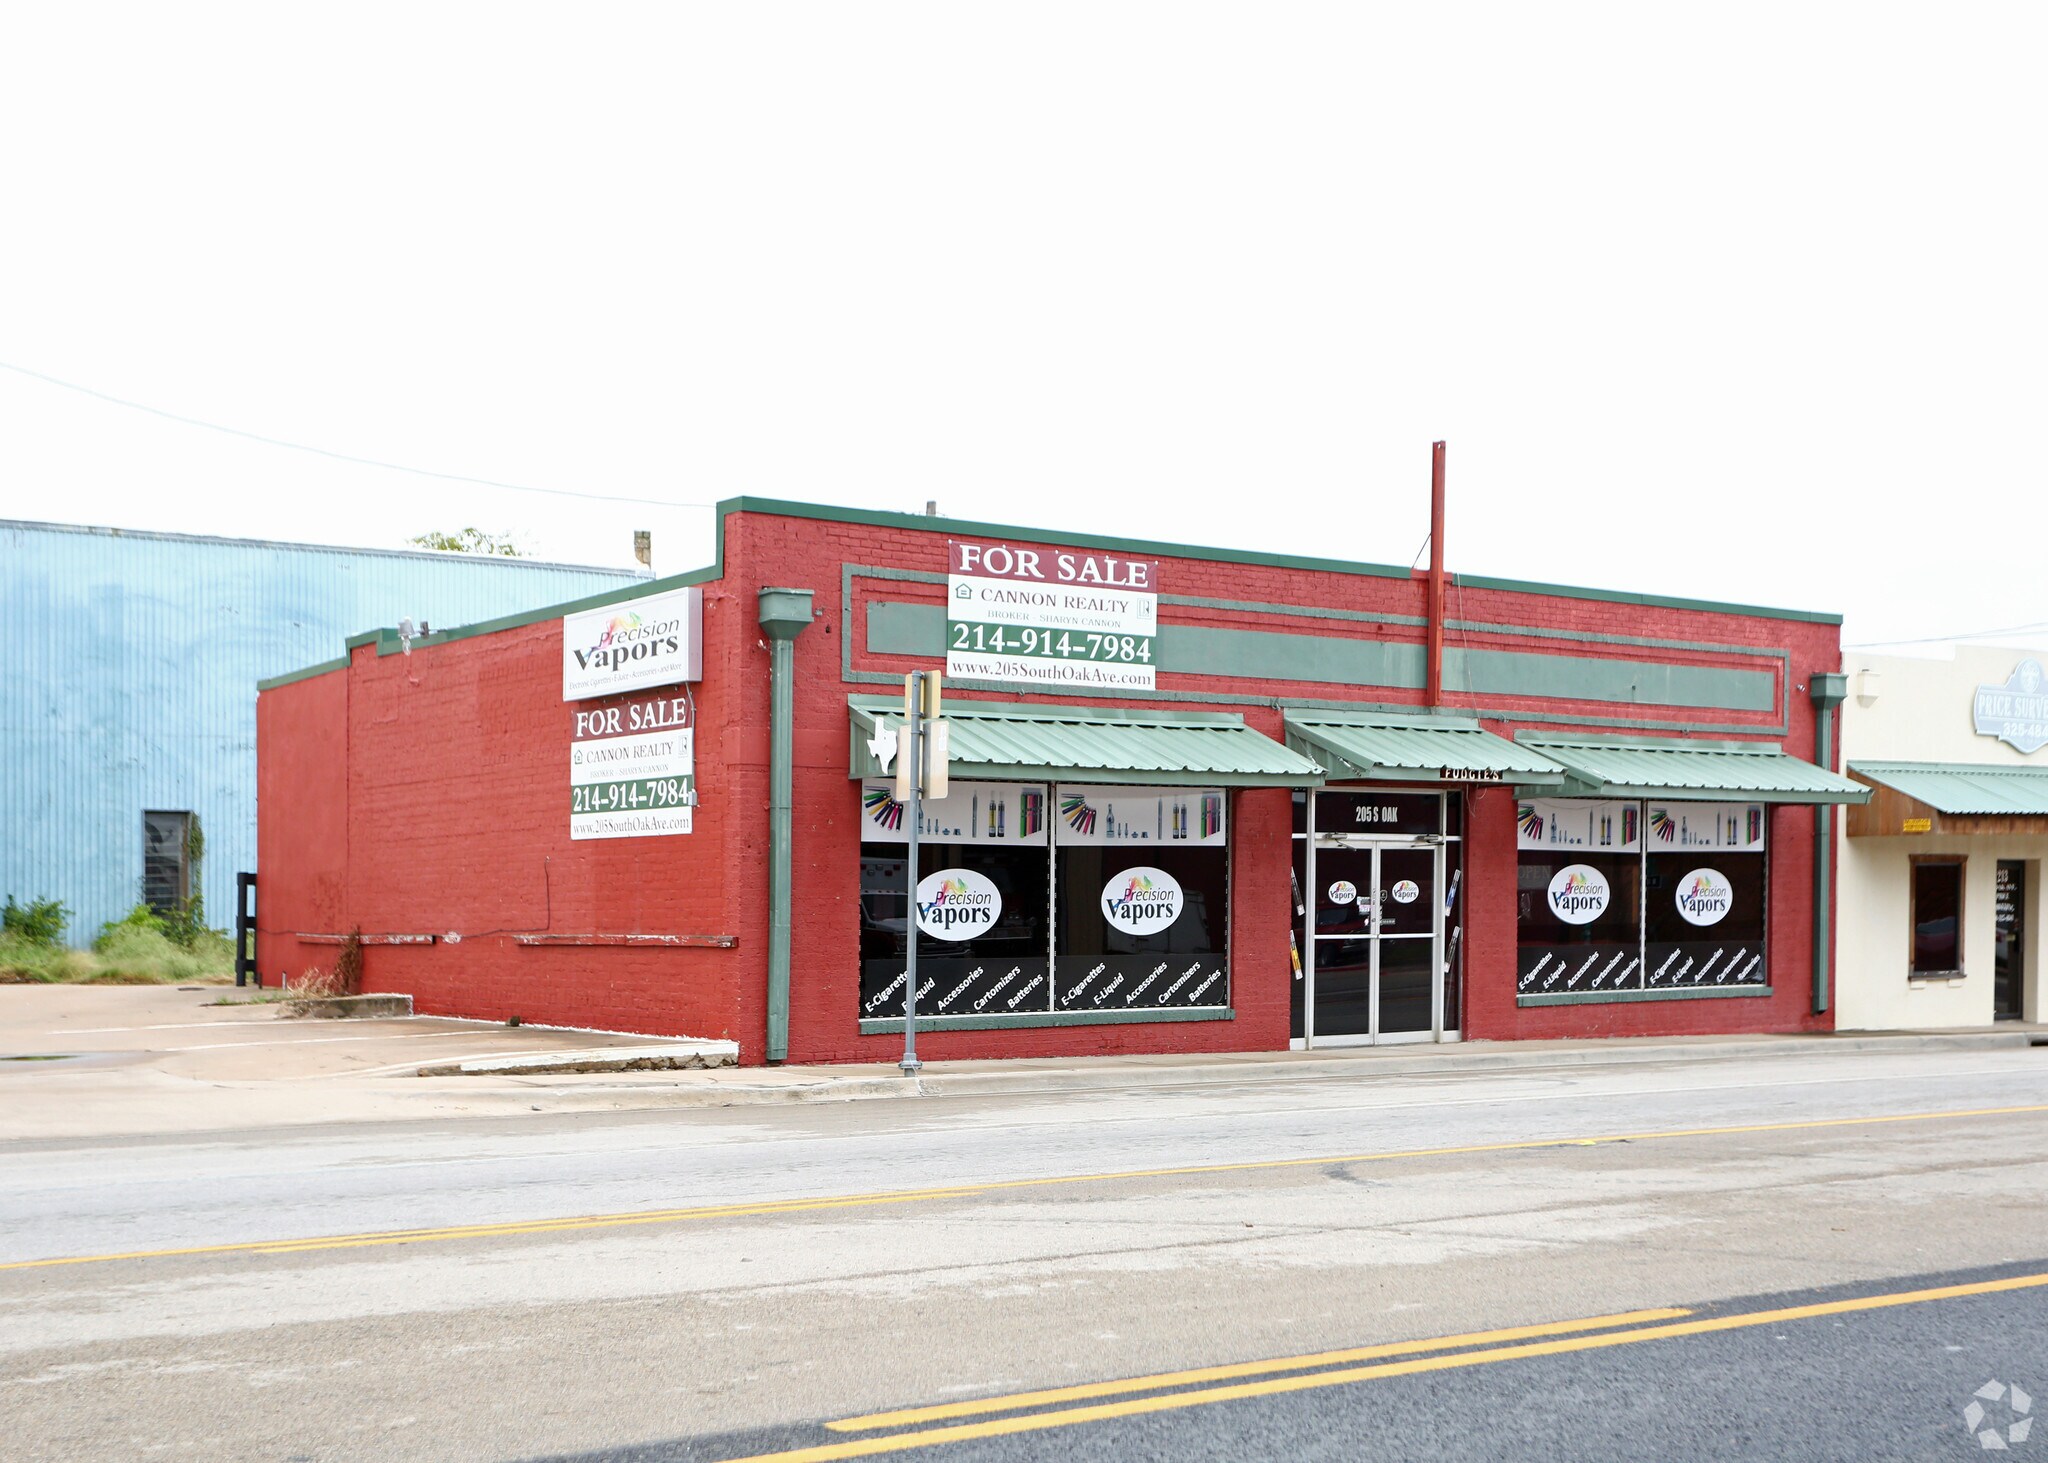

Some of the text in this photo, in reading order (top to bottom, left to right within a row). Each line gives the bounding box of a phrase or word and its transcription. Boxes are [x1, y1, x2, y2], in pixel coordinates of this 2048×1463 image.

[959, 544, 1149, 588] FOR SALE
[981, 588, 1129, 613] CANNON REALTY
[599, 619, 679, 648] Precision
[987, 610, 1029, 621] BROKER
[1039, 614, 1079, 625] SHARYN
[1081, 618, 1121, 628] CANNON
[573, 635, 679, 672] Vapors
[953, 623, 1151, 663] 214-914-7984
[952, 662, 1151, 685] www.205SouthOakAve.com
[576, 698, 686, 737] FOR SALE
[586, 741, 674, 764] CANNON REALTY
[573, 777, 689, 812] 214-914-7984
[573, 816, 689, 834] www.205SouthOakAve.com
[1355, 805, 1398, 822] 205 S OAK
[935, 890, 992, 905] Precision
[1123, 887, 1175, 901] Precision
[1330, 890, 1355, 901] Vapors
[1393, 889, 1417, 900] Vapors
[1552, 892, 1603, 915] Vapors
[1565, 882, 1604, 895] Precision
[1691, 885, 1727, 897] Precision
[917, 902, 991, 930] Vapors
[1106, 899, 1174, 925] Vapors
[1680, 894, 1726, 917] Vapors
[1061, 962, 1106, 1006] E-Cigarettes
[1125, 961, 1168, 1005] Accessories
[1158, 961, 1201, 1004] Cartomizers
[1518, 951, 1553, 990] E-Cigarettes
[1542, 960, 1567, 989] E-Liquid
[1567, 951, 1599, 988] Accessories
[1592, 950, 1624, 988] Cartomizers
[1614, 957, 1640, 987] Batteries
[865, 969, 907, 1013] E-Cigarette
[901, 977, 936, 1012] Equid
[937, 965, 984, 1011] Accessories
[973, 965, 1021, 1011] Cartomizers
[1007, 973, 1044, 1010] Batteries
[1093, 972, 1125, 1006] E-Liquid
[1188, 968, 1222, 1003] Batteries
